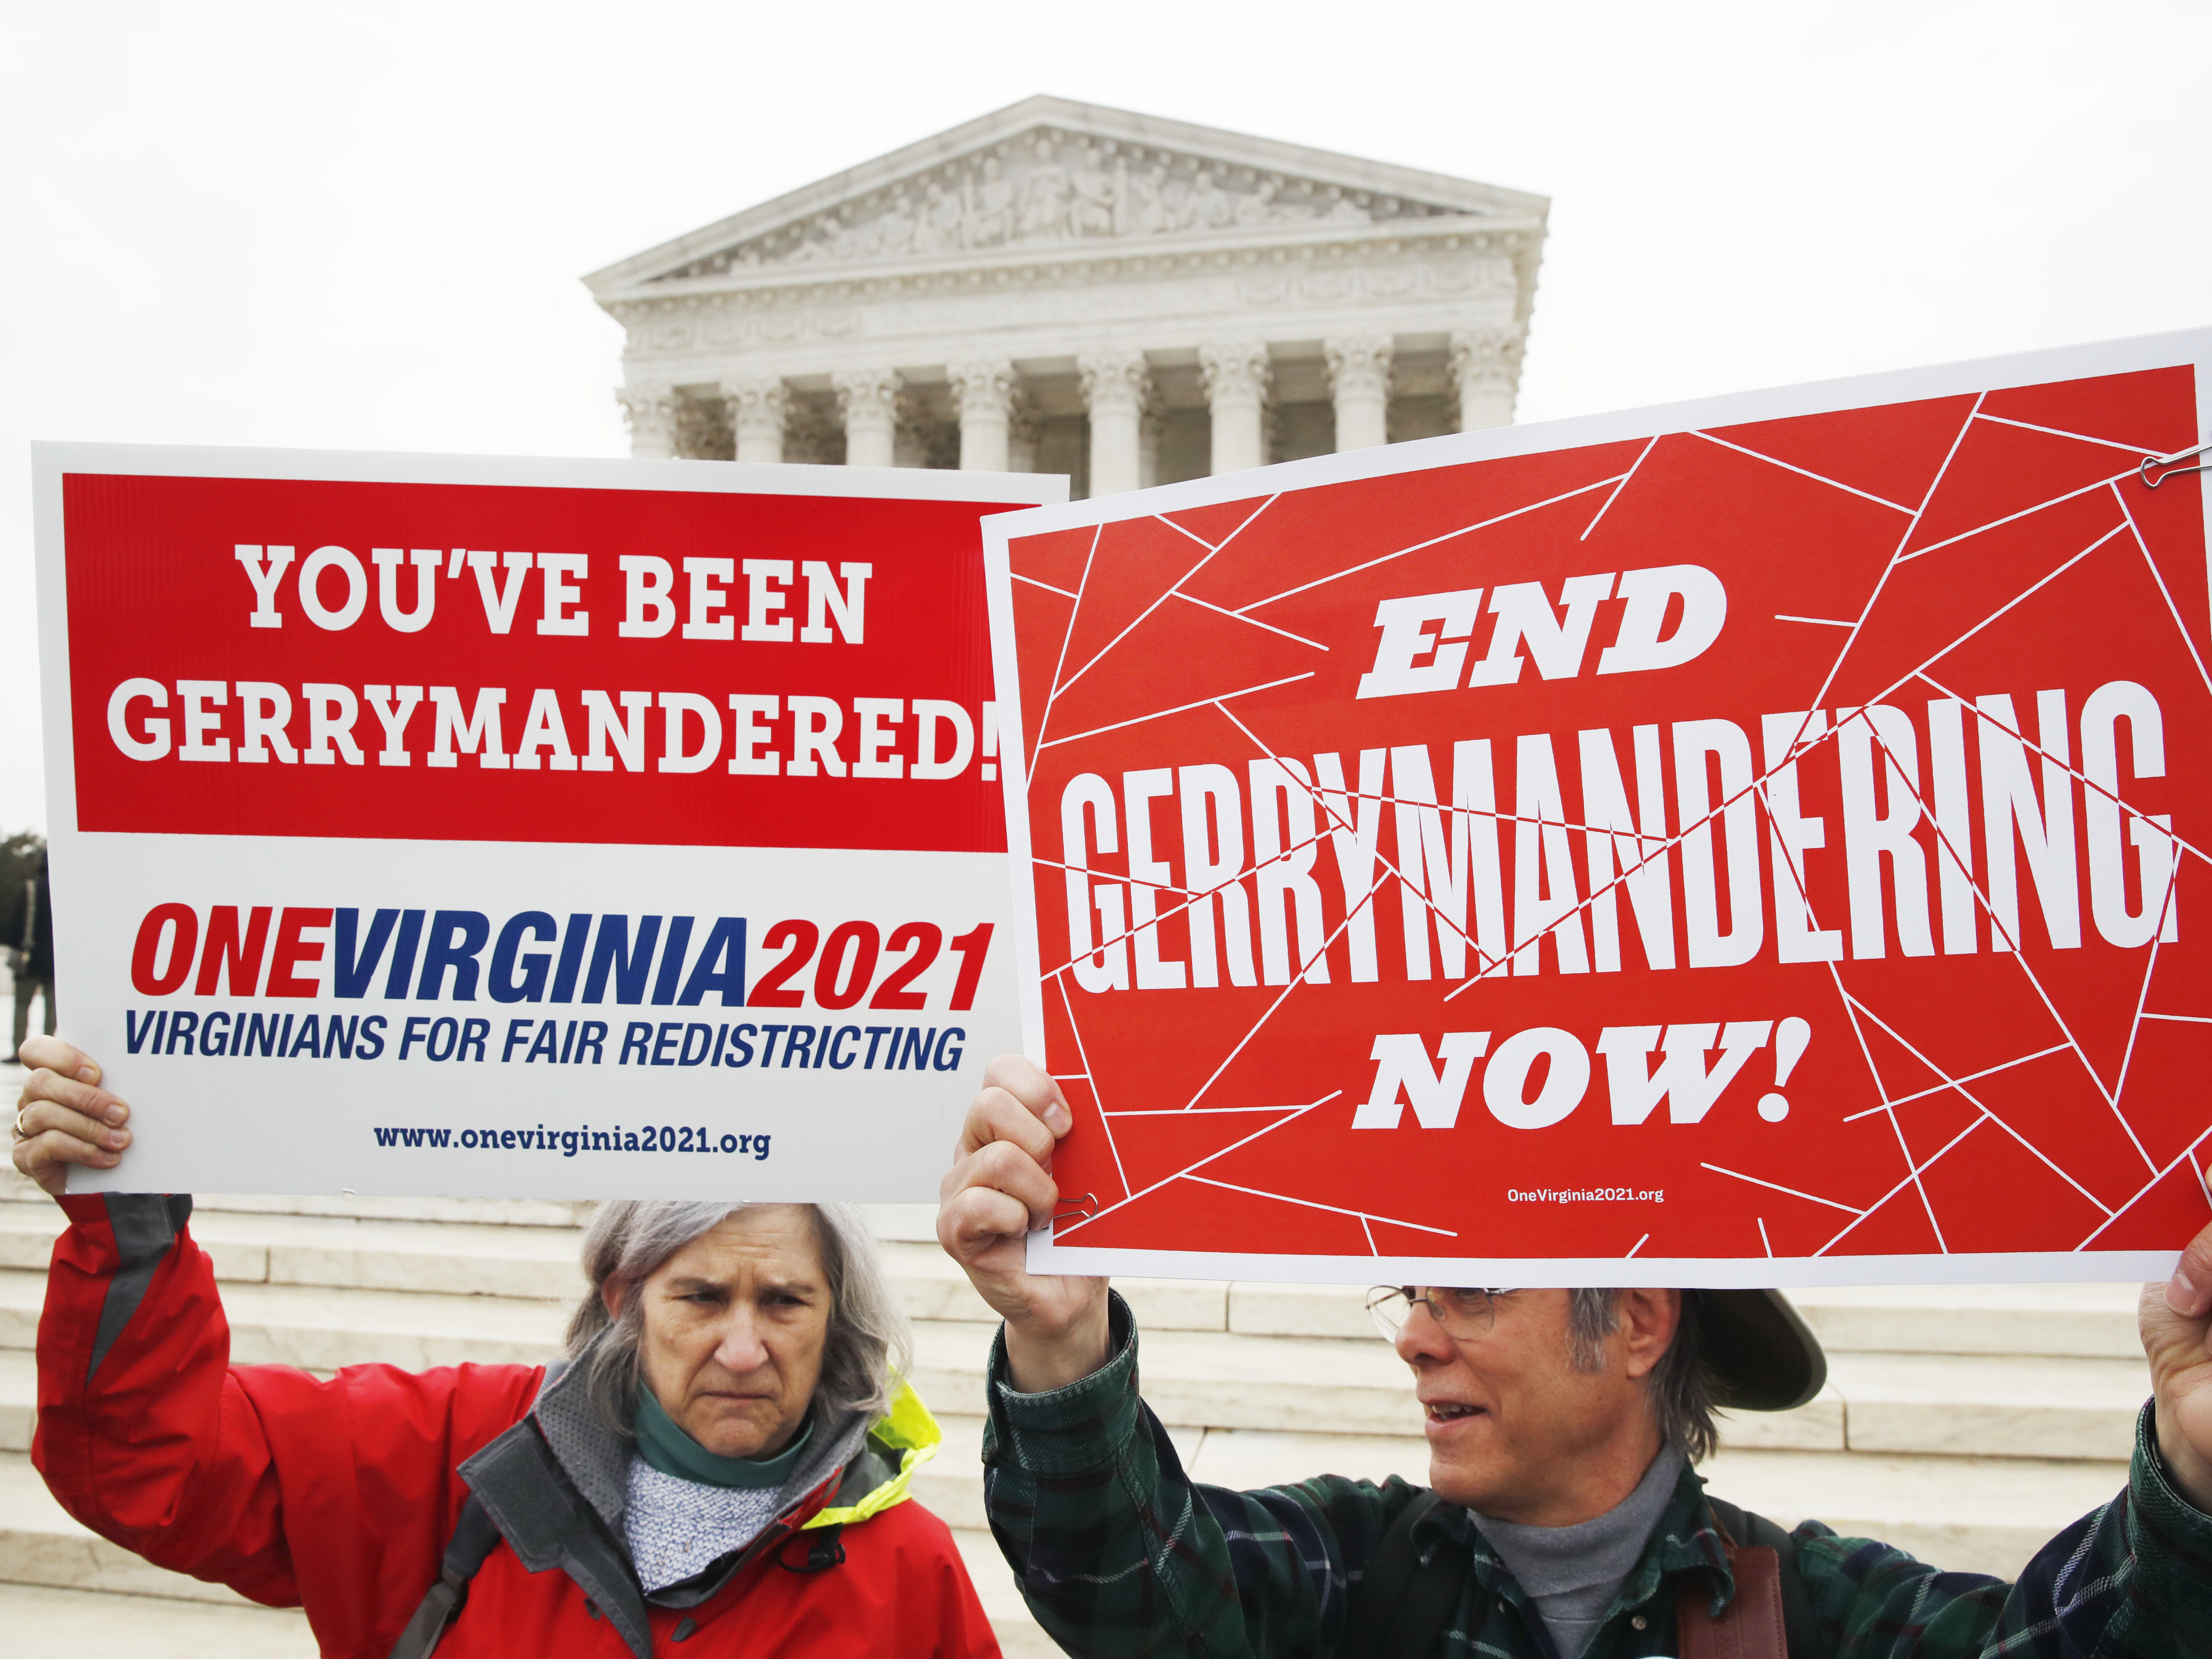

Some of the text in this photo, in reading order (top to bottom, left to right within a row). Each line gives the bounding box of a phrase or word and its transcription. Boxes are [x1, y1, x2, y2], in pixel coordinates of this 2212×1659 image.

[235, 545, 873, 644] YOU'VE BEEN
[1356, 565, 1727, 700] END
[107, 678, 998, 781] GERRYMANDERED!
[1061, 680, 2179, 994] GERRYMANDERING
[131, 903, 995, 1011] ONEVIRGINIA2021
[127, 1010, 966, 1071] VIRGINIANS FOR FAIR REDISTRICTING
[1351, 1017, 1811, 1130] NOW!
[374, 1124, 771, 1160] www.onevirginia2021.org
[1507, 1188, 1664, 1204] OneVirginia2021.org
